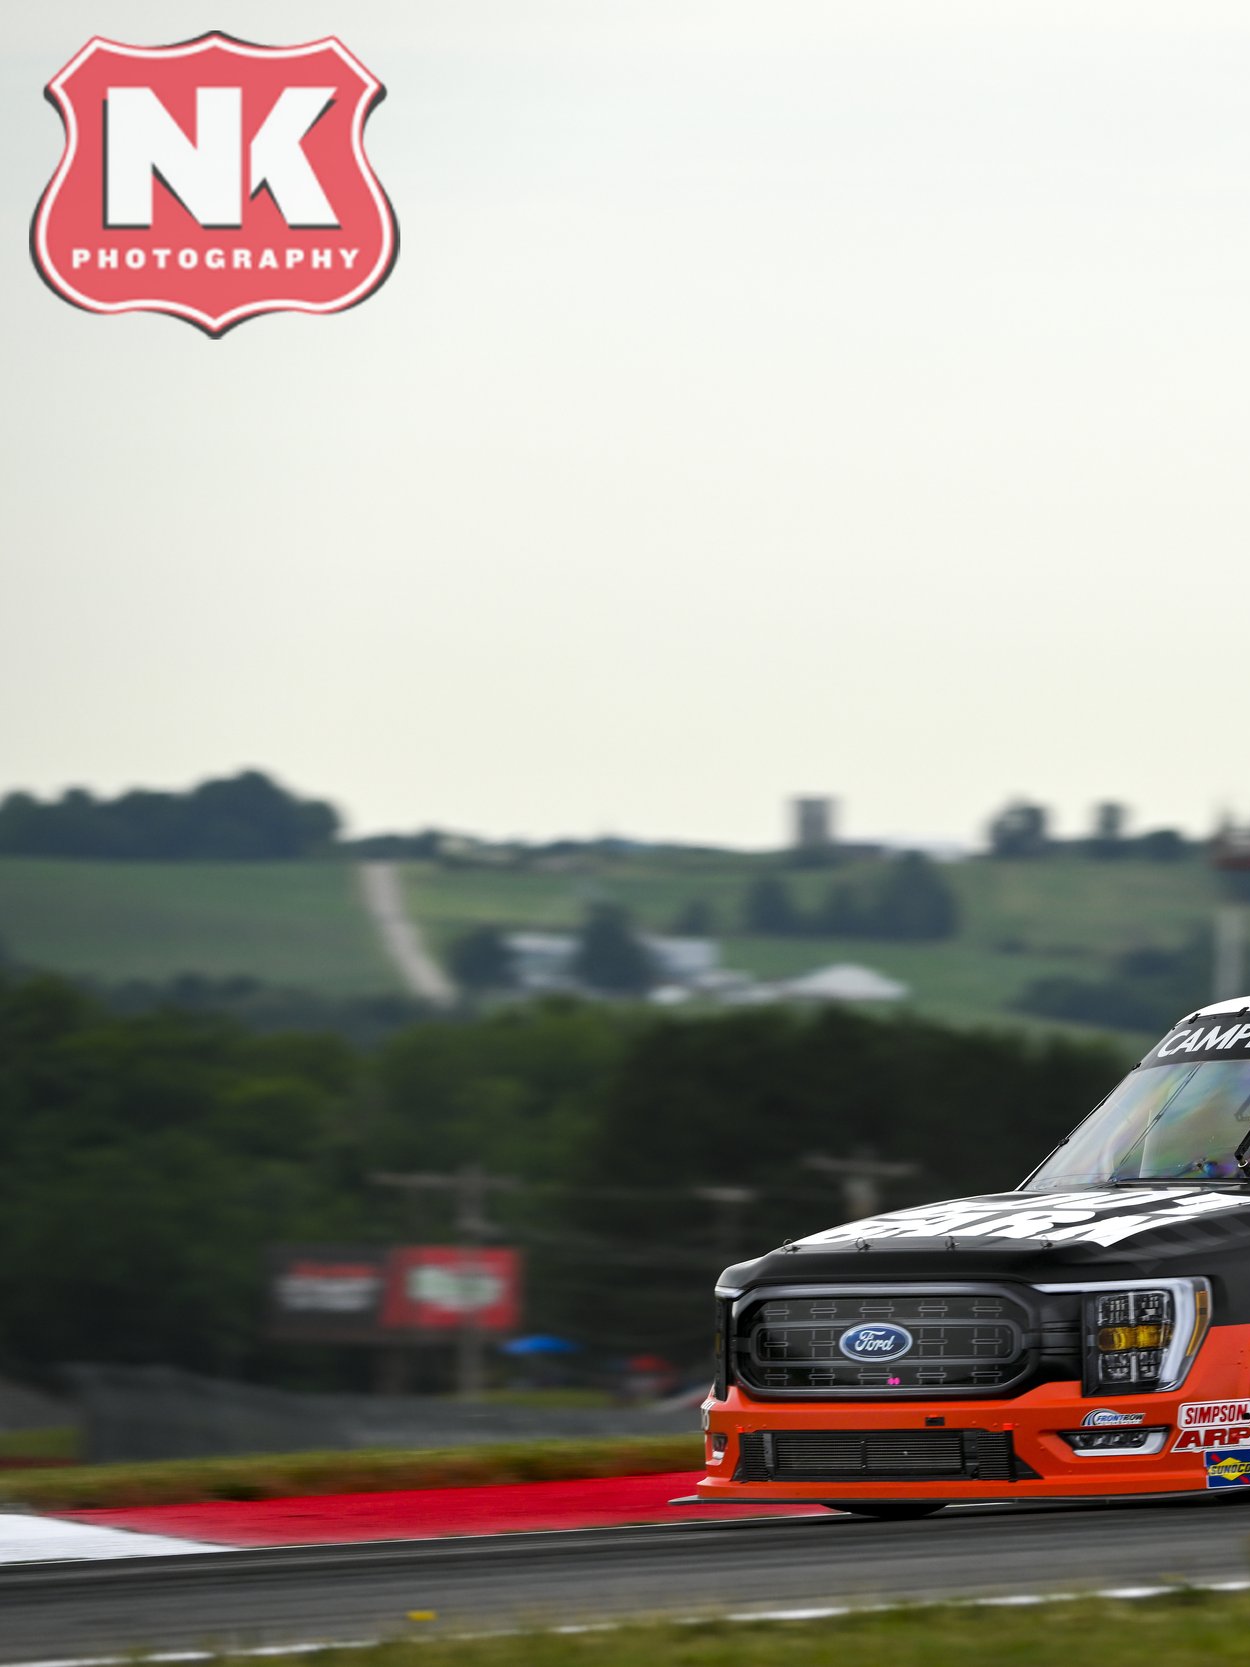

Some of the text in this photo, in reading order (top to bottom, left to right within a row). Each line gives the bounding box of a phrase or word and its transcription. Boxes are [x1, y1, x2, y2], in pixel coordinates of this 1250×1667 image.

[855, 1330, 896, 1351] Ford
[1185, 1404, 1248, 1425] SIMPSON
[1175, 1427, 1250, 1449] ARP
